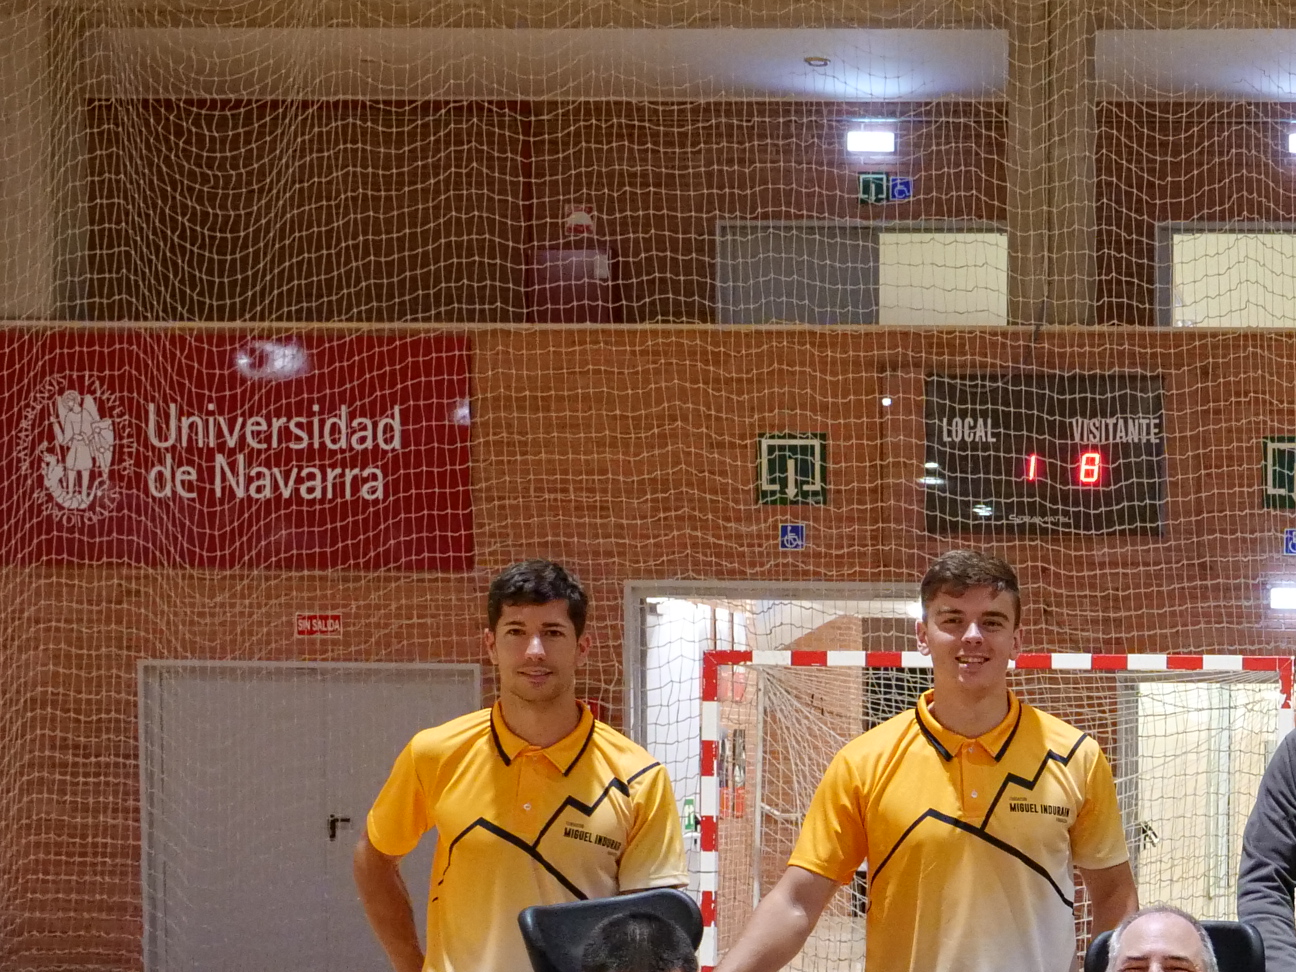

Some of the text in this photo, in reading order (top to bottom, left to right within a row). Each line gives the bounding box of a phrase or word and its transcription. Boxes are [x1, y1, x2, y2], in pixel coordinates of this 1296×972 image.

[149, 402, 402, 451] Universidad
[942, 417, 1161, 444] LOCAL VISITANTE
[149, 453, 384, 501] de Navarra
[1029, 452, 1101, 483] 1 8
[1009, 802, 1070, 818] MIGUEL INDURAIN
[564, 827, 593, 843] MIGUEL
